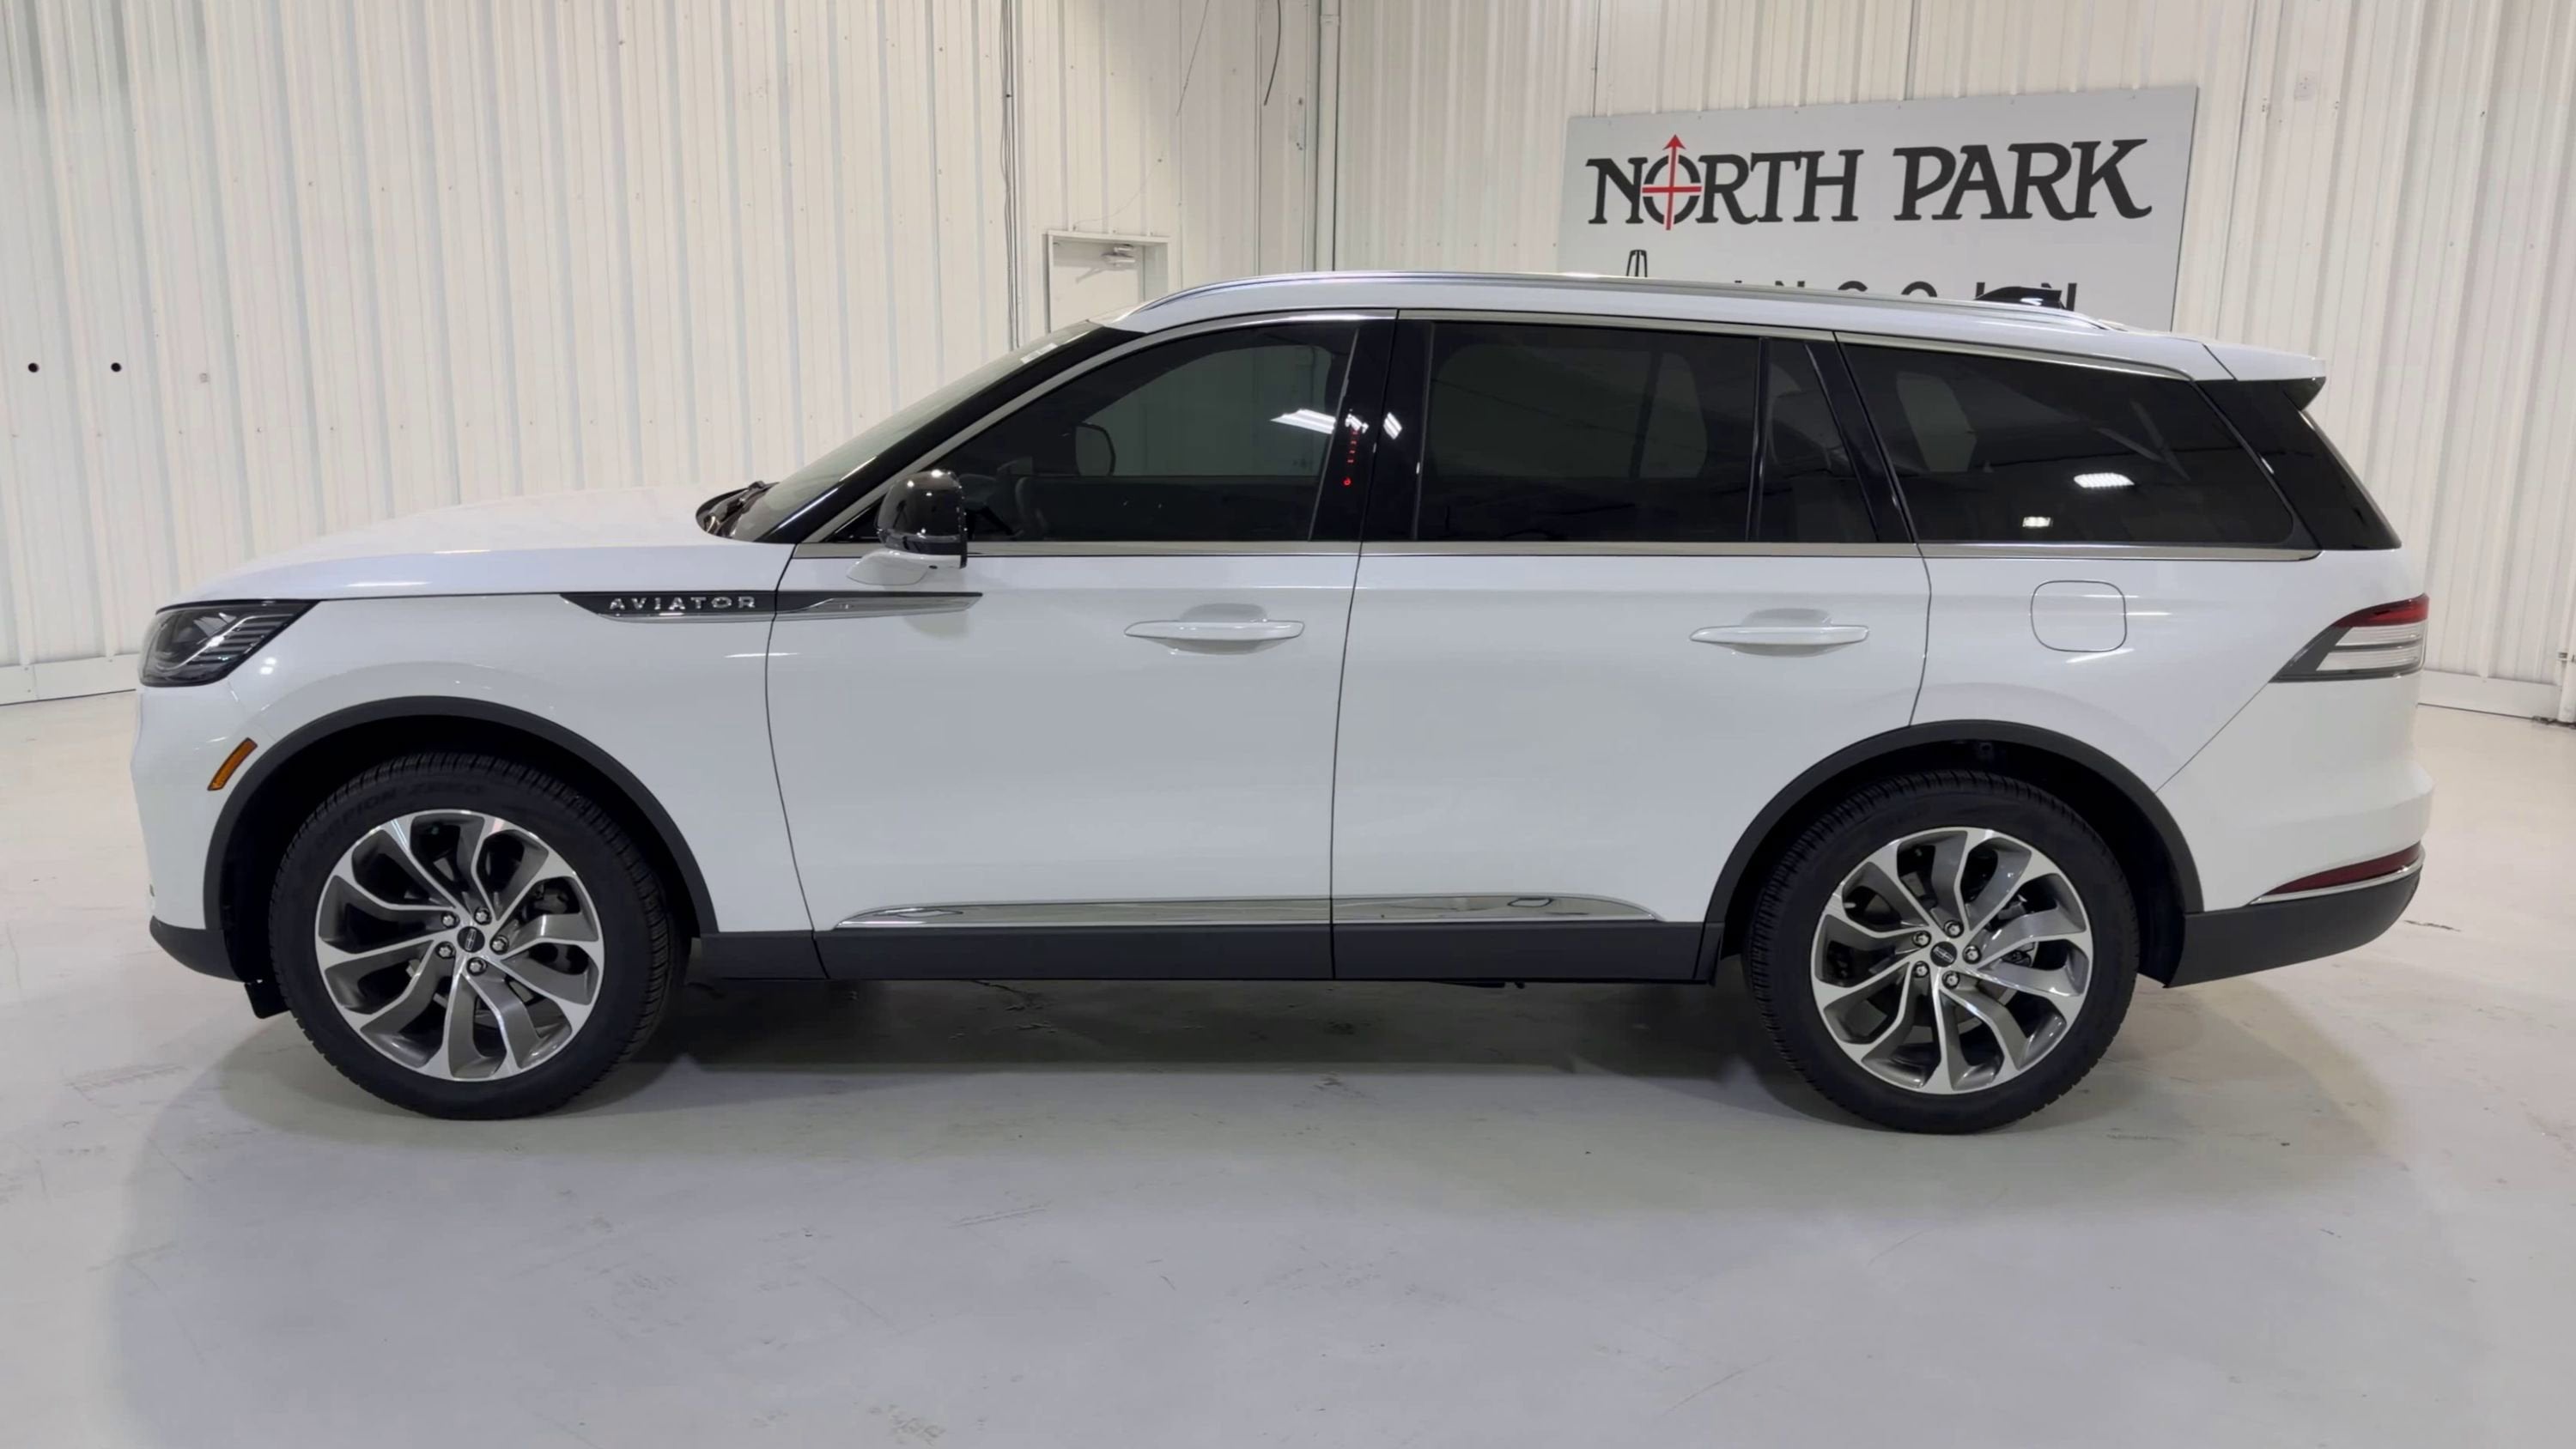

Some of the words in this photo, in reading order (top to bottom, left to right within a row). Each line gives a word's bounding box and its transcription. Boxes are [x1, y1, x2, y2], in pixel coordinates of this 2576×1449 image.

[1586, 149, 1864, 226] NORTH
[1893, 138, 2153, 222] PARK
[609, 596, 756, 610] AVIATOR
